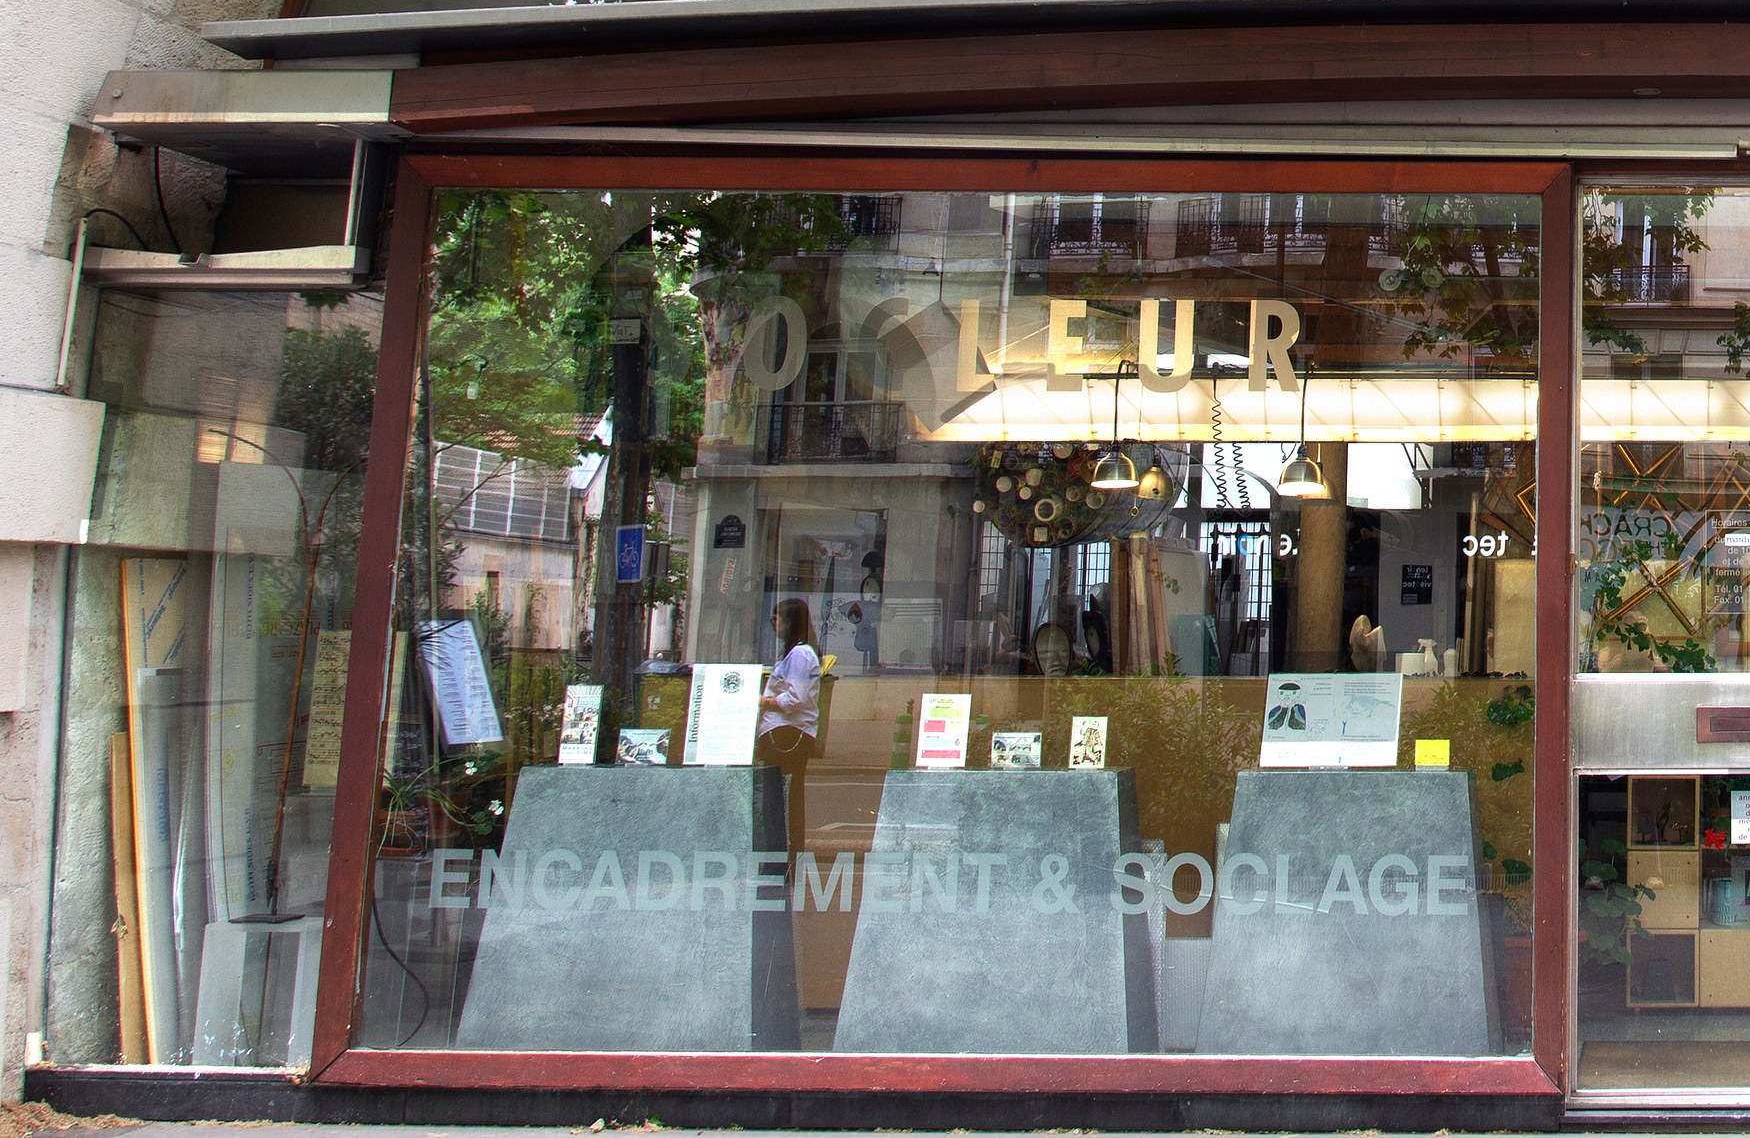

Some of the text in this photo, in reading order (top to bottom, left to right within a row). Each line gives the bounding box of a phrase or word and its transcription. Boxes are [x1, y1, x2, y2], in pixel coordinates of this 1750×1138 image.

[1711, 518, 1748, 527] Horaires
[1715, 535, 1725, 544] du
[1715, 569, 1740, 577] fermé
[1715, 584, 1731, 593] Tél.
[1733, 585, 1743, 593] 01
[1714, 595, 1744, 604] Fax. 01
[688, 684, 705, 744] Information
[429, 848, 1469, 916] ENCADREMENT & SOCLAGE
